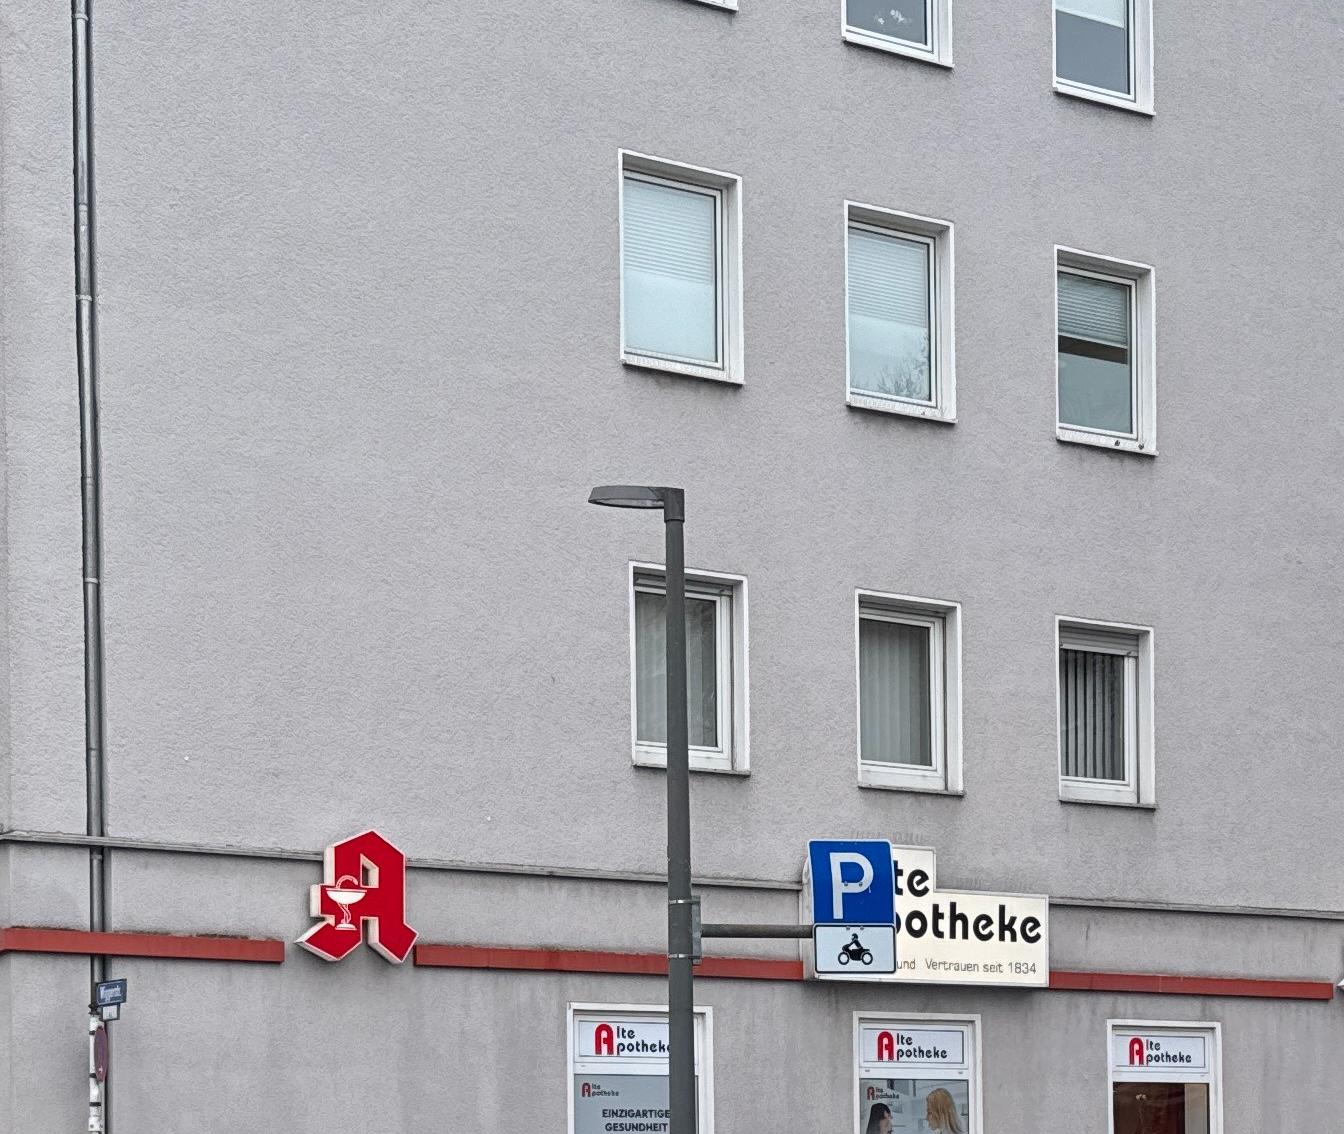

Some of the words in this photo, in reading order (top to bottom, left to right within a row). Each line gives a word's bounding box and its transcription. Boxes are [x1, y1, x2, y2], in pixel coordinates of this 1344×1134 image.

[829, 852, 874, 919] P
[893, 860, 930, 897] te
[895, 902, 1042, 944] otheke
[925, 959, 980, 973] Vertrauen
[983, 962, 1003, 974] seit
[1008, 962, 1036, 974] 1834
[602, 1109, 670, 1118] EINZIGARTIGE
[605, 1123, 668, 1132] GESUNDHEIT
